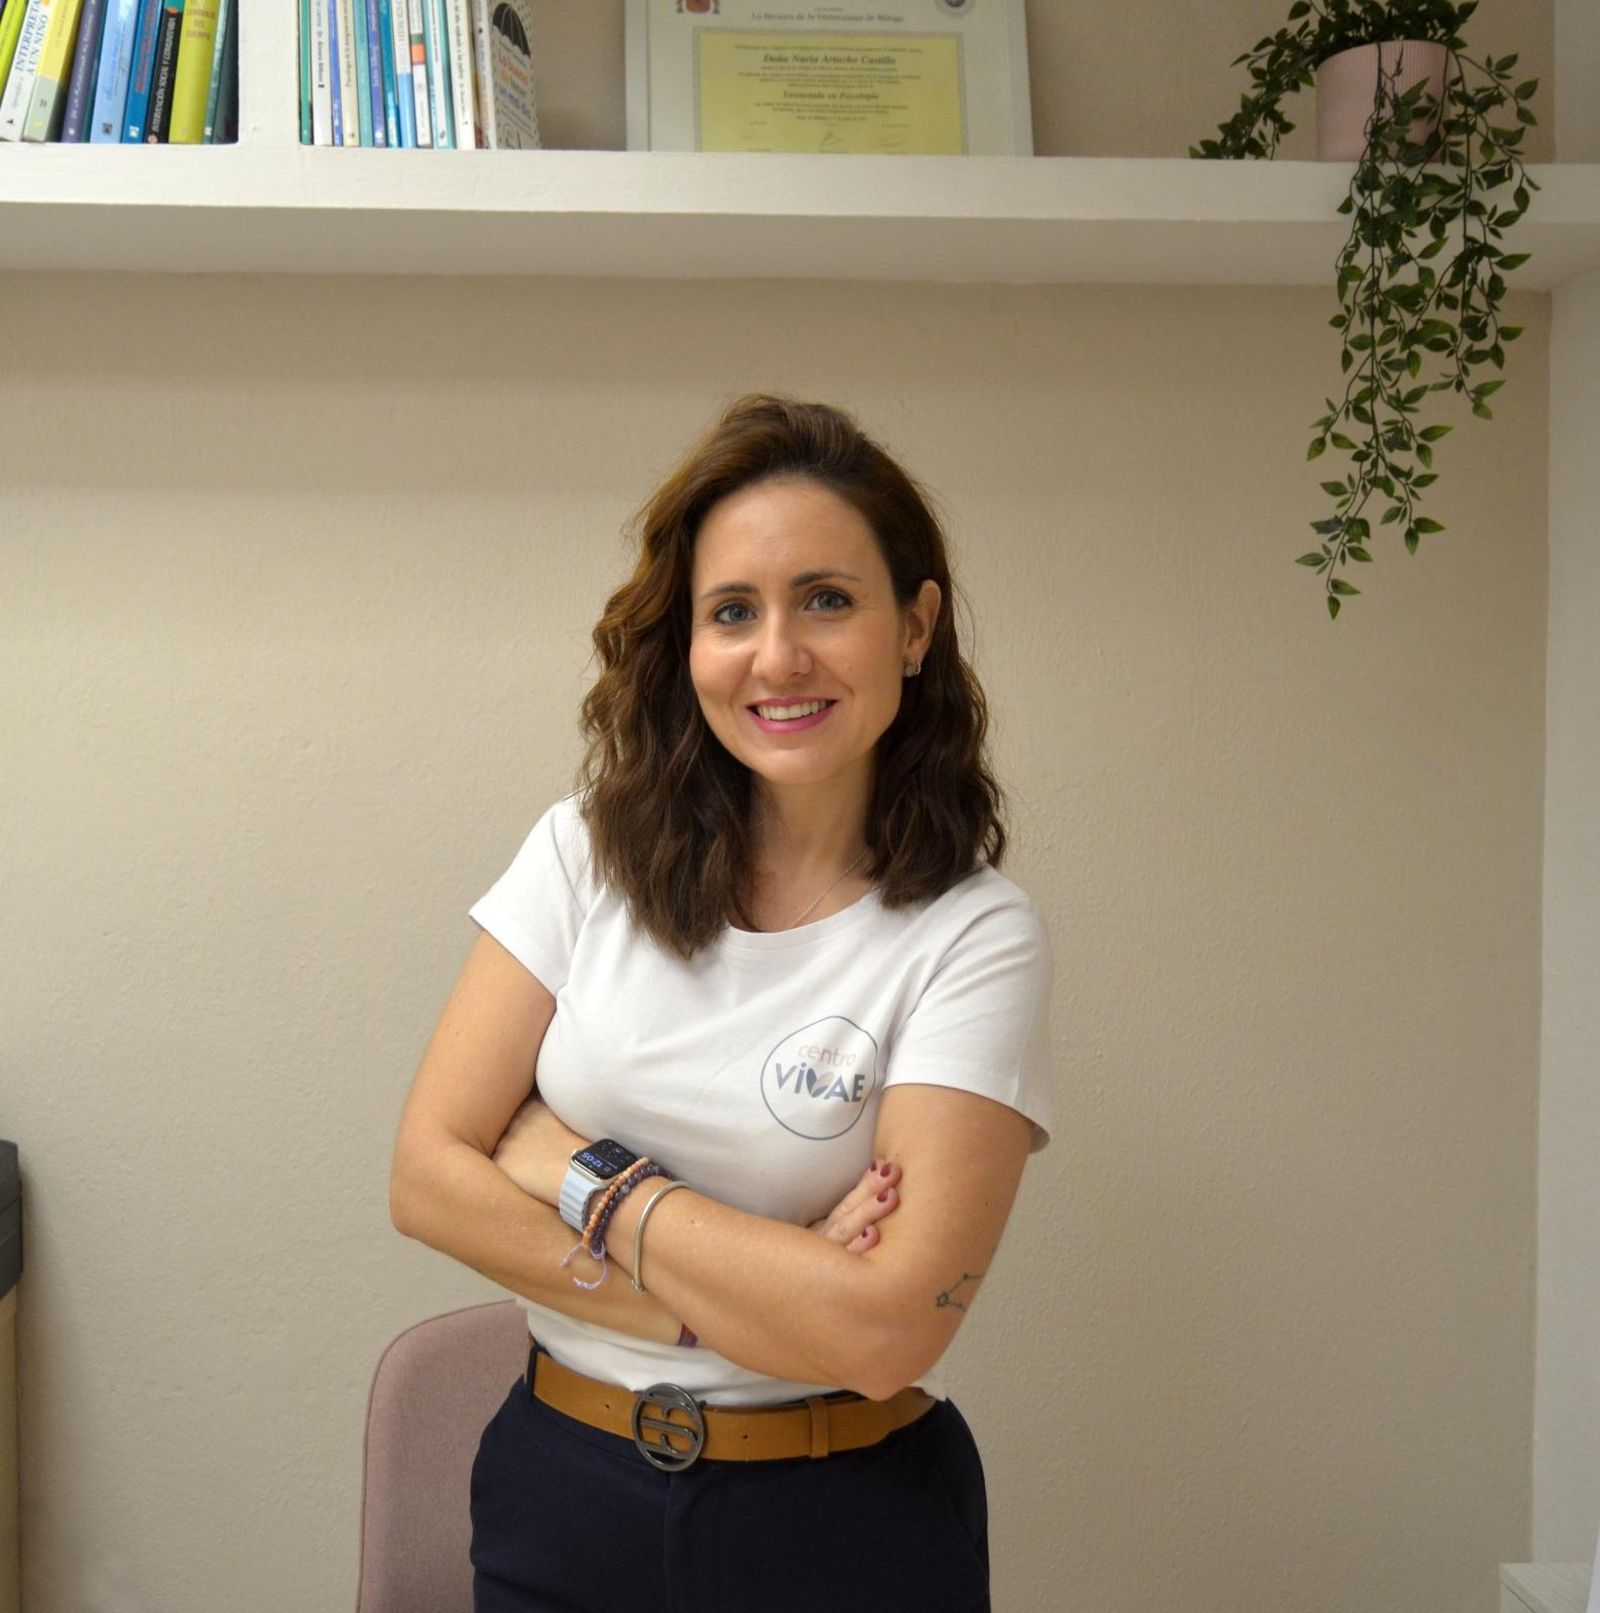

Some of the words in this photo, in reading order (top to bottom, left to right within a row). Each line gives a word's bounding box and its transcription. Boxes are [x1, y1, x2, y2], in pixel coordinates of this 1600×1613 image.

[28, 48, 39, 65] UN
[158, 66, 169, 87] SOCIAL
[798, 1045, 857, 1067] centro
